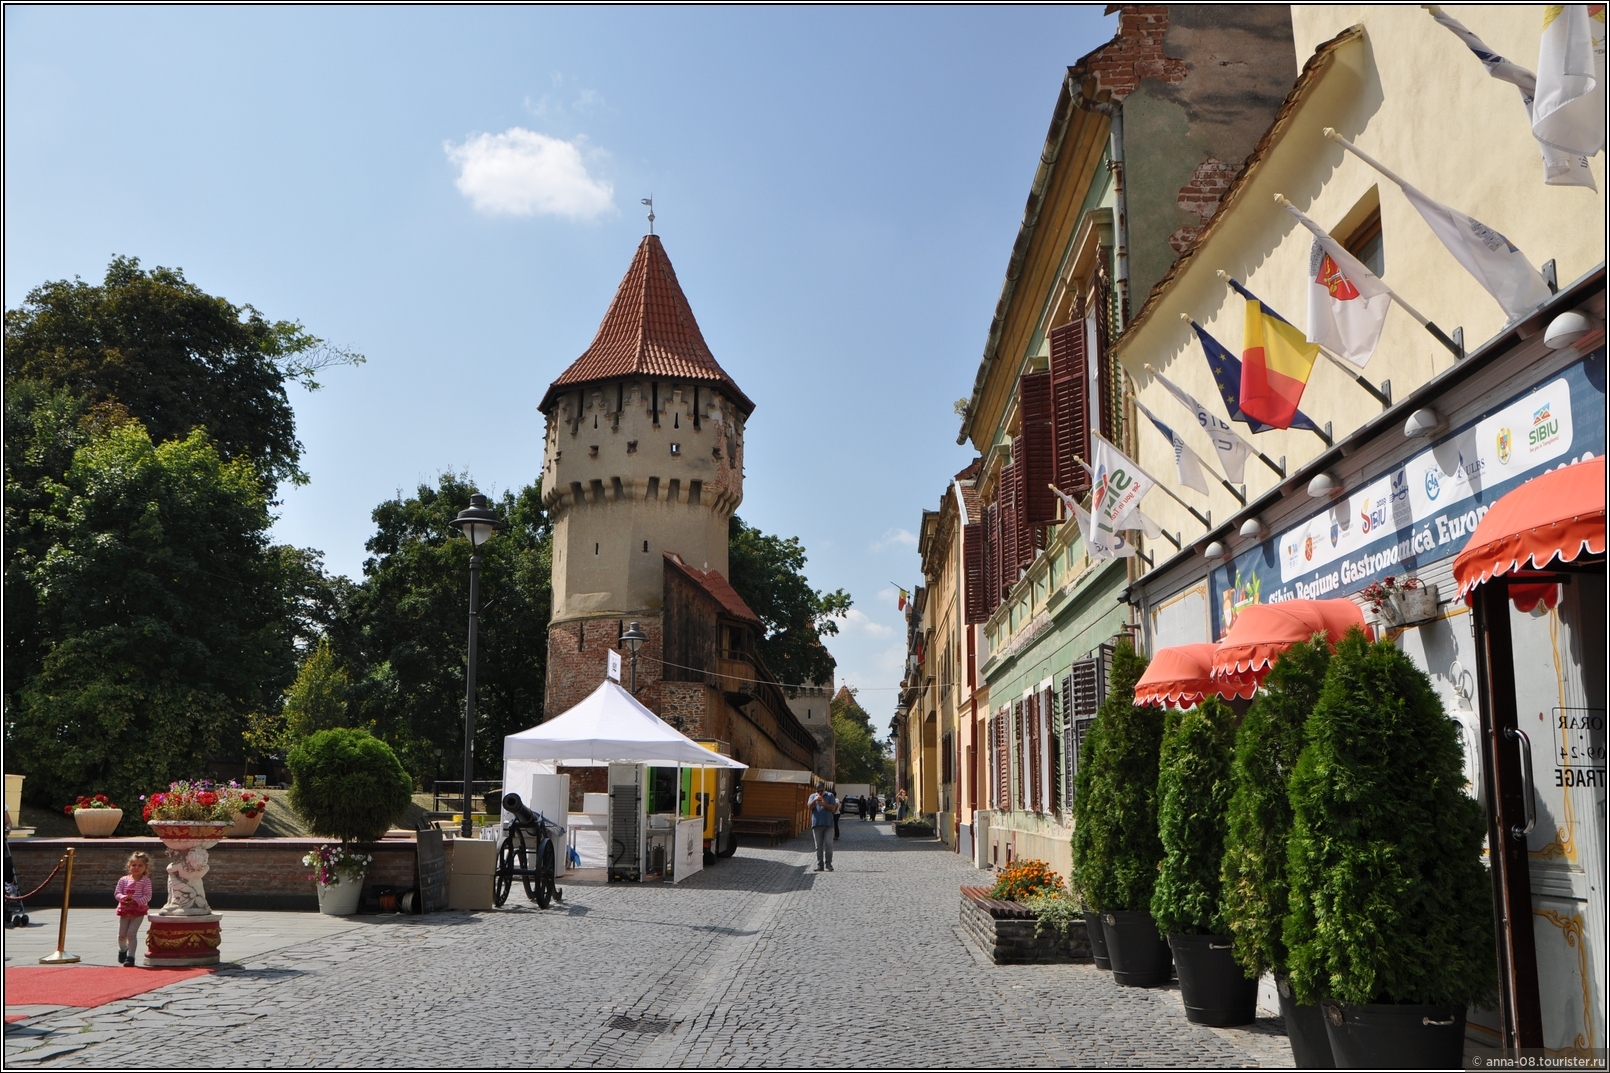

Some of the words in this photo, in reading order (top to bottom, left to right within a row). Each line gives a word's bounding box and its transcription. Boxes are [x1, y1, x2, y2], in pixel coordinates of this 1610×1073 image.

[1529, 419, 1558, 445] SIBIU
[1466, 458, 1485, 475] ULBS
[1361, 506, 1387, 534] SIBIU
[1295, 571, 1339, 601] Regiune
[1341, 522, 1436, 585] Gastronomică
